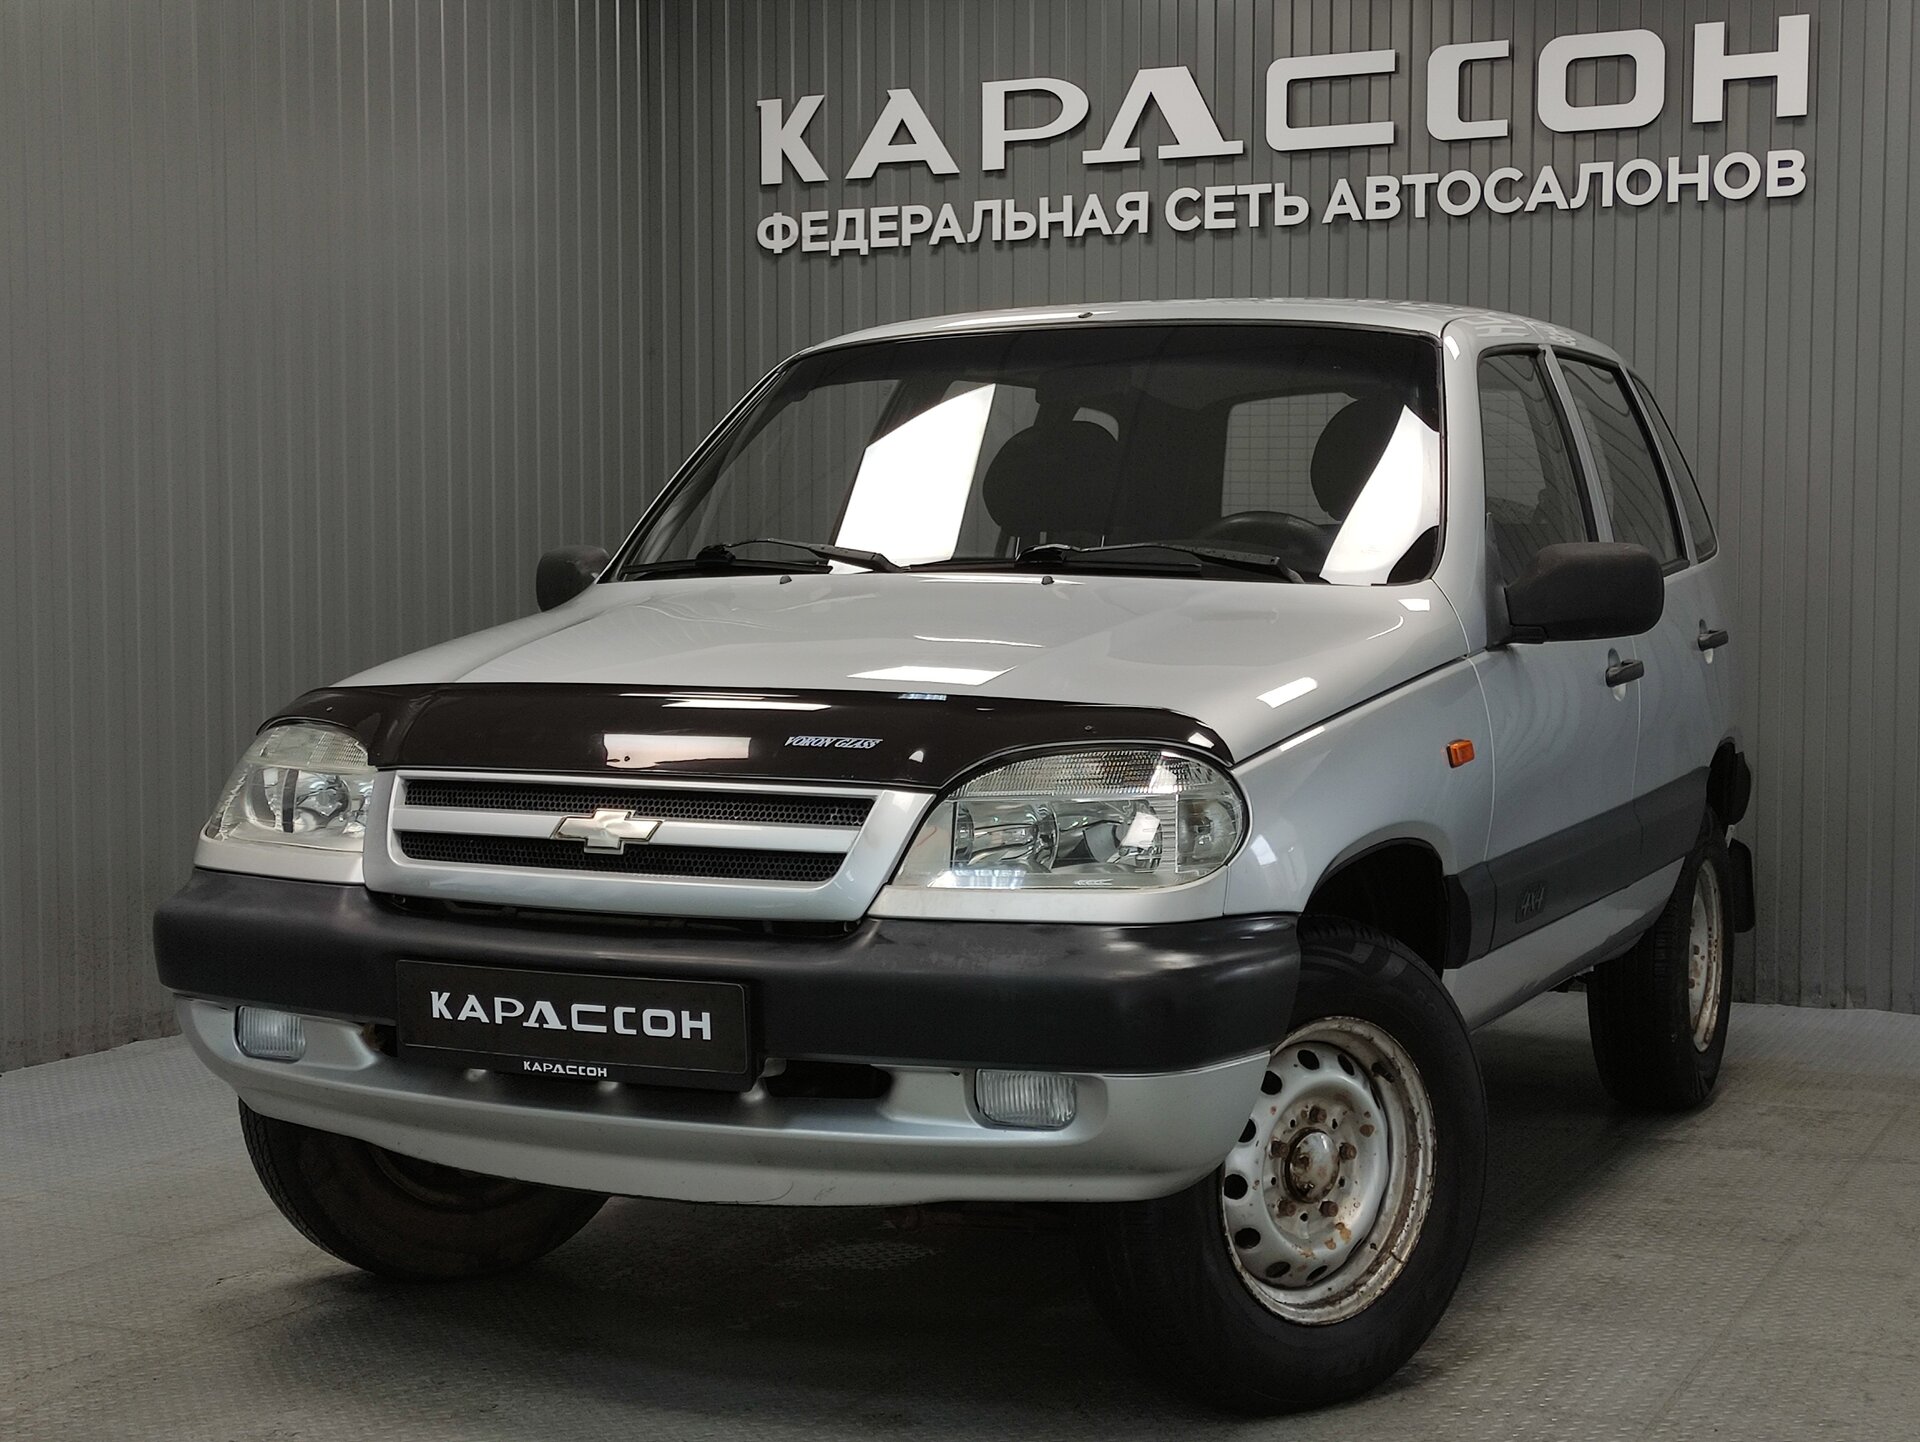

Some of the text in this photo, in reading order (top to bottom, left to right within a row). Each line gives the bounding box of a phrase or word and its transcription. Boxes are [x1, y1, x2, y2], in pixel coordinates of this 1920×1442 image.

[757, 149, 1807, 256] ФЕДЕРАЛЬНАЯ СЕТЬ АВТОСАЛОНОВ
[834, 737, 883, 749] GLASS
